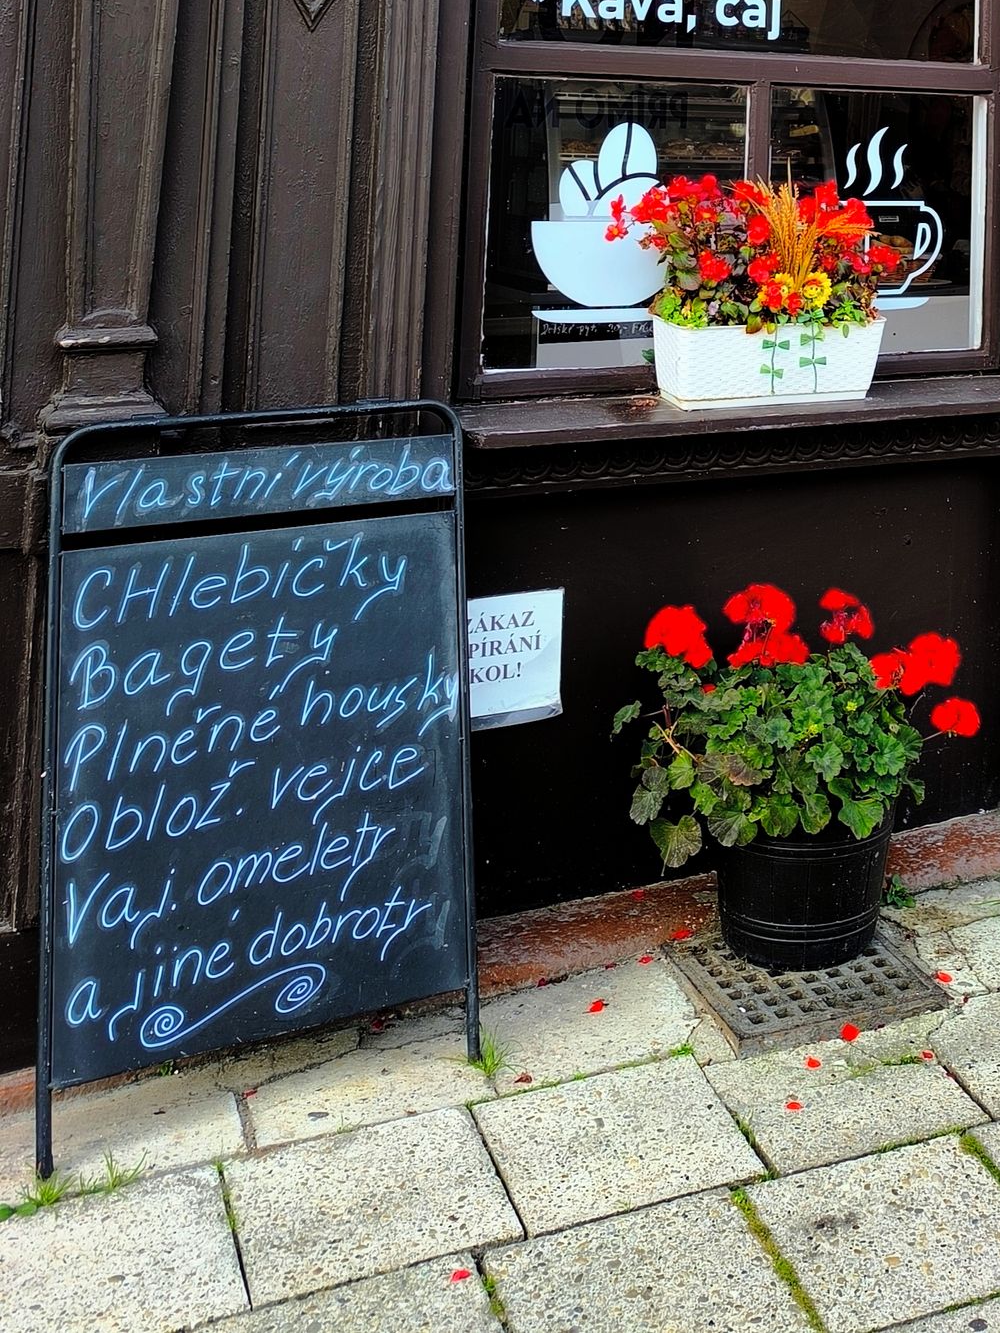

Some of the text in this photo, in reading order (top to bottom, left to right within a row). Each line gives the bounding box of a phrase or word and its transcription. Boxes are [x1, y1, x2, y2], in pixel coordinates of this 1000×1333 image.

[82, 445, 454, 521] Vlastní výroba
[70, 616, 339, 716] Bagety
[469, 629, 541, 659] PÍRÁNÍ
[470, 662, 522, 684] KOL!
[301, 654, 458, 736] housky
[61, 746, 425, 862] Oblož. vejce
[69, 869, 176, 949] Vaj.
[67, 886, 432, 1041] a jiné dobroty
